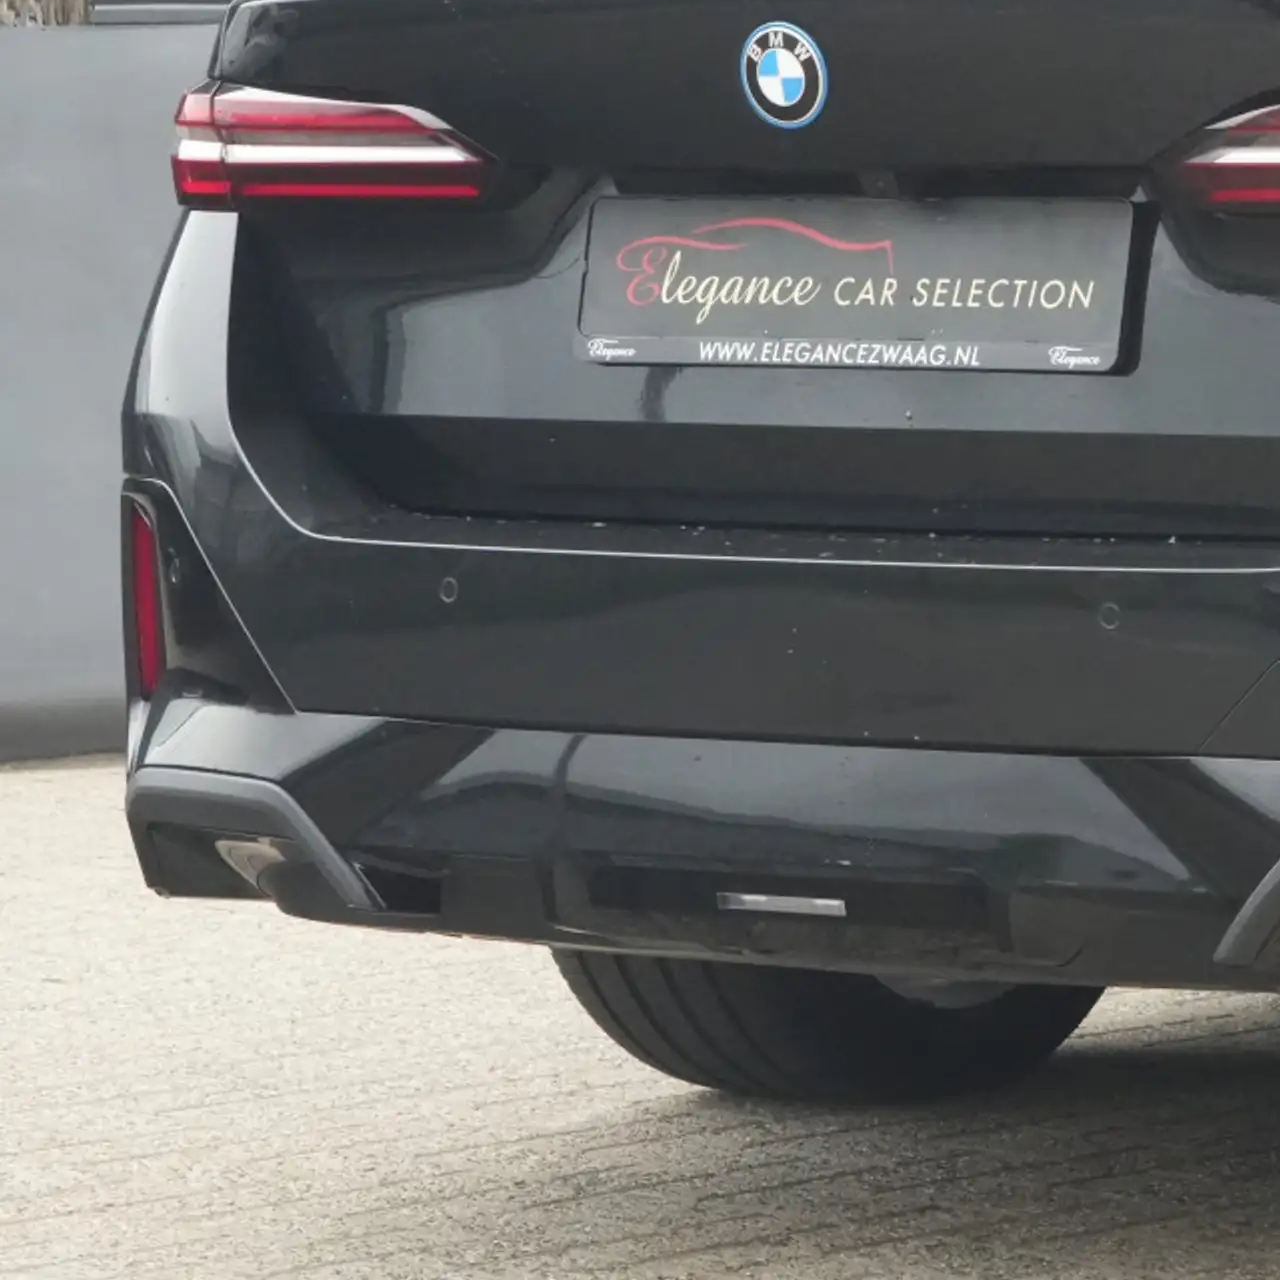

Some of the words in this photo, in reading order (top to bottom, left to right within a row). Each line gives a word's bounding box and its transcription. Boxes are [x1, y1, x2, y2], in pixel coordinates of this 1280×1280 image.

[748, 30, 813, 63] BMW
[616, 237, 822, 325] Elegance
[833, 276, 898, 307] CAR
[911, 277, 1096, 310] SELECTION
[587, 338, 637, 361] Elegance
[699, 339, 981, 366] WWW.ELEGANCEZWAAG.NL
[1048, 345, 1101, 369] Elegance
